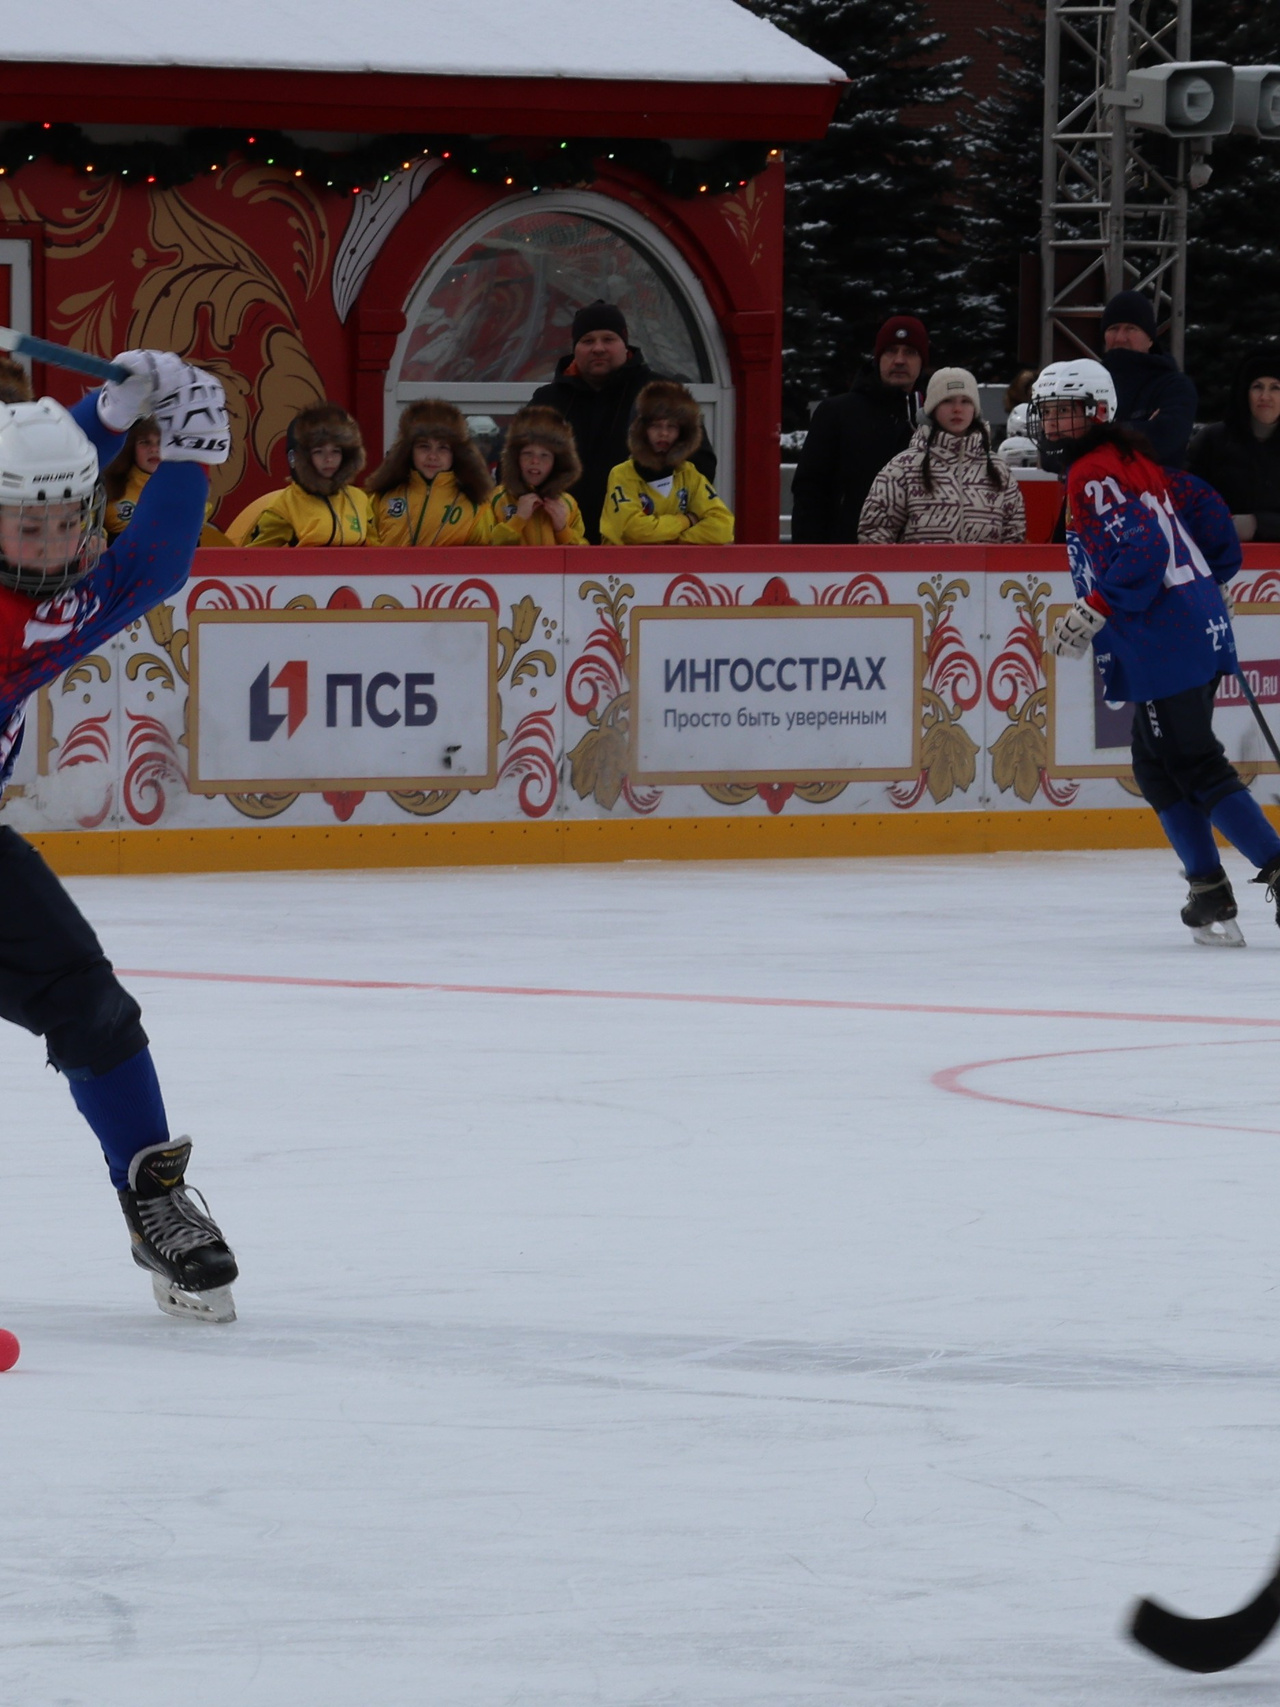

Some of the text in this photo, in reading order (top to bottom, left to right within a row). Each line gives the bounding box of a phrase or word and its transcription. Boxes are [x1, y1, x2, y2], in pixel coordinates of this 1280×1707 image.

[32, 472, 75, 484] BAUER
[1084, 476, 1127, 516] 21
[441, 505, 463, 525] 10
[664, 656, 887, 693] ИНГОССТРАХ
[326, 672, 438, 728] ПСБ
[664, 707, 887, 732] Просто быть уверенным
